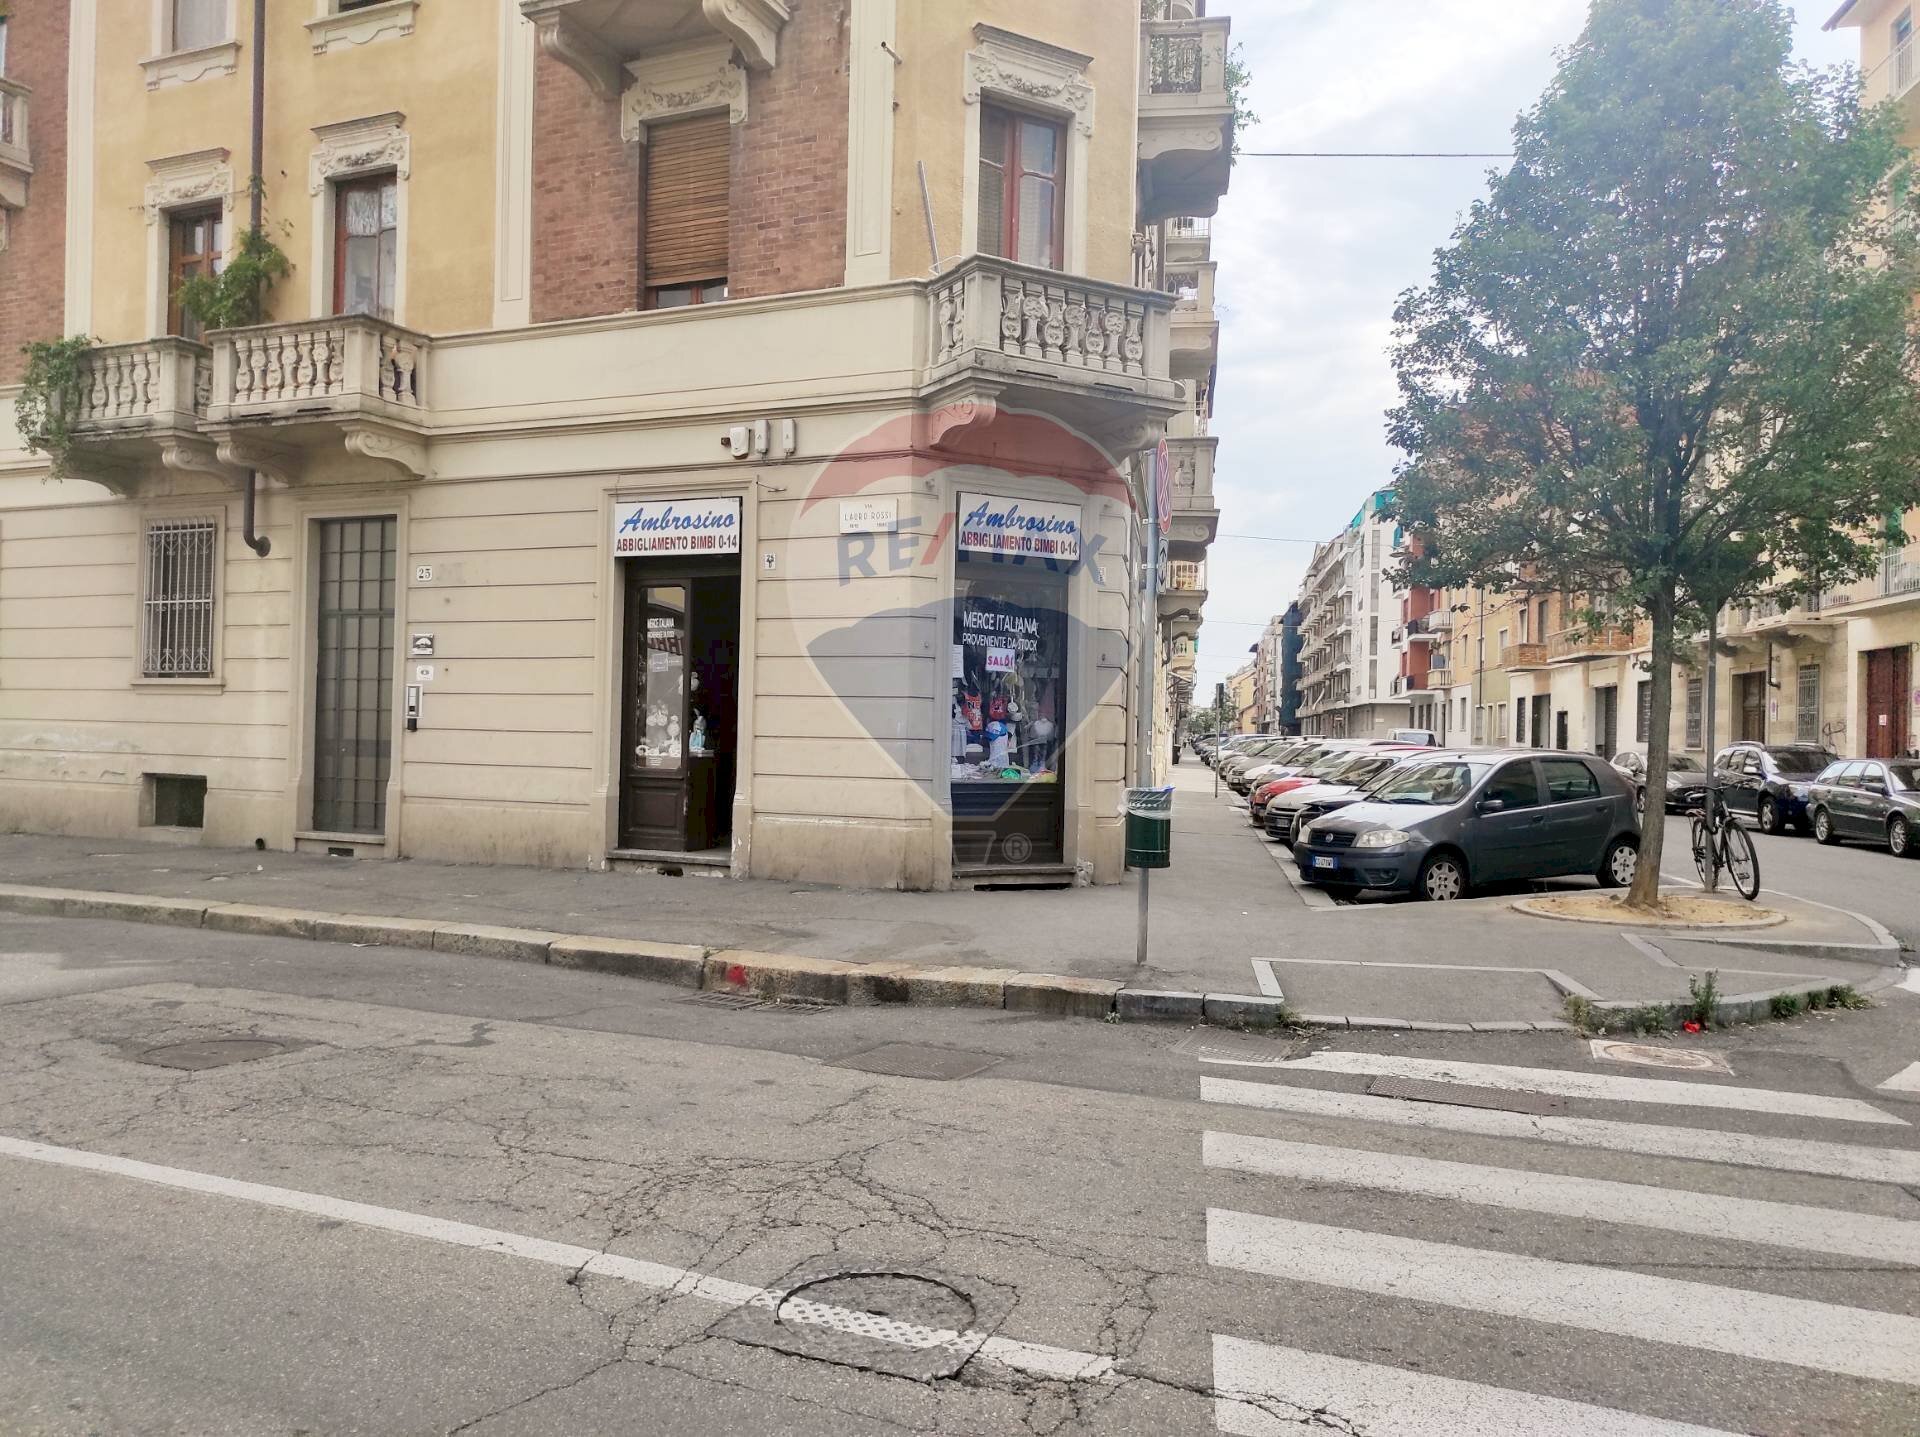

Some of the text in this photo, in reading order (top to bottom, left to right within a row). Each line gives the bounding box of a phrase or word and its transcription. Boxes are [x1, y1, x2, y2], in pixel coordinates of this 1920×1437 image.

[618, 506, 736, 534] Ambrosino
[870, 510, 892, 520] ROSSI
[963, 500, 1078, 534] Ambrosino
[616, 534, 737, 552] ABBIGLIAMENTO BIMBI 0-14
[960, 530, 1078, 556] ABBIGLIAMENTO BIMBI 0-14
[963, 610, 1038, 635] MERCE ITALIANA
[962, 632, 1038, 652] PROVENIENTE DA STOCK
